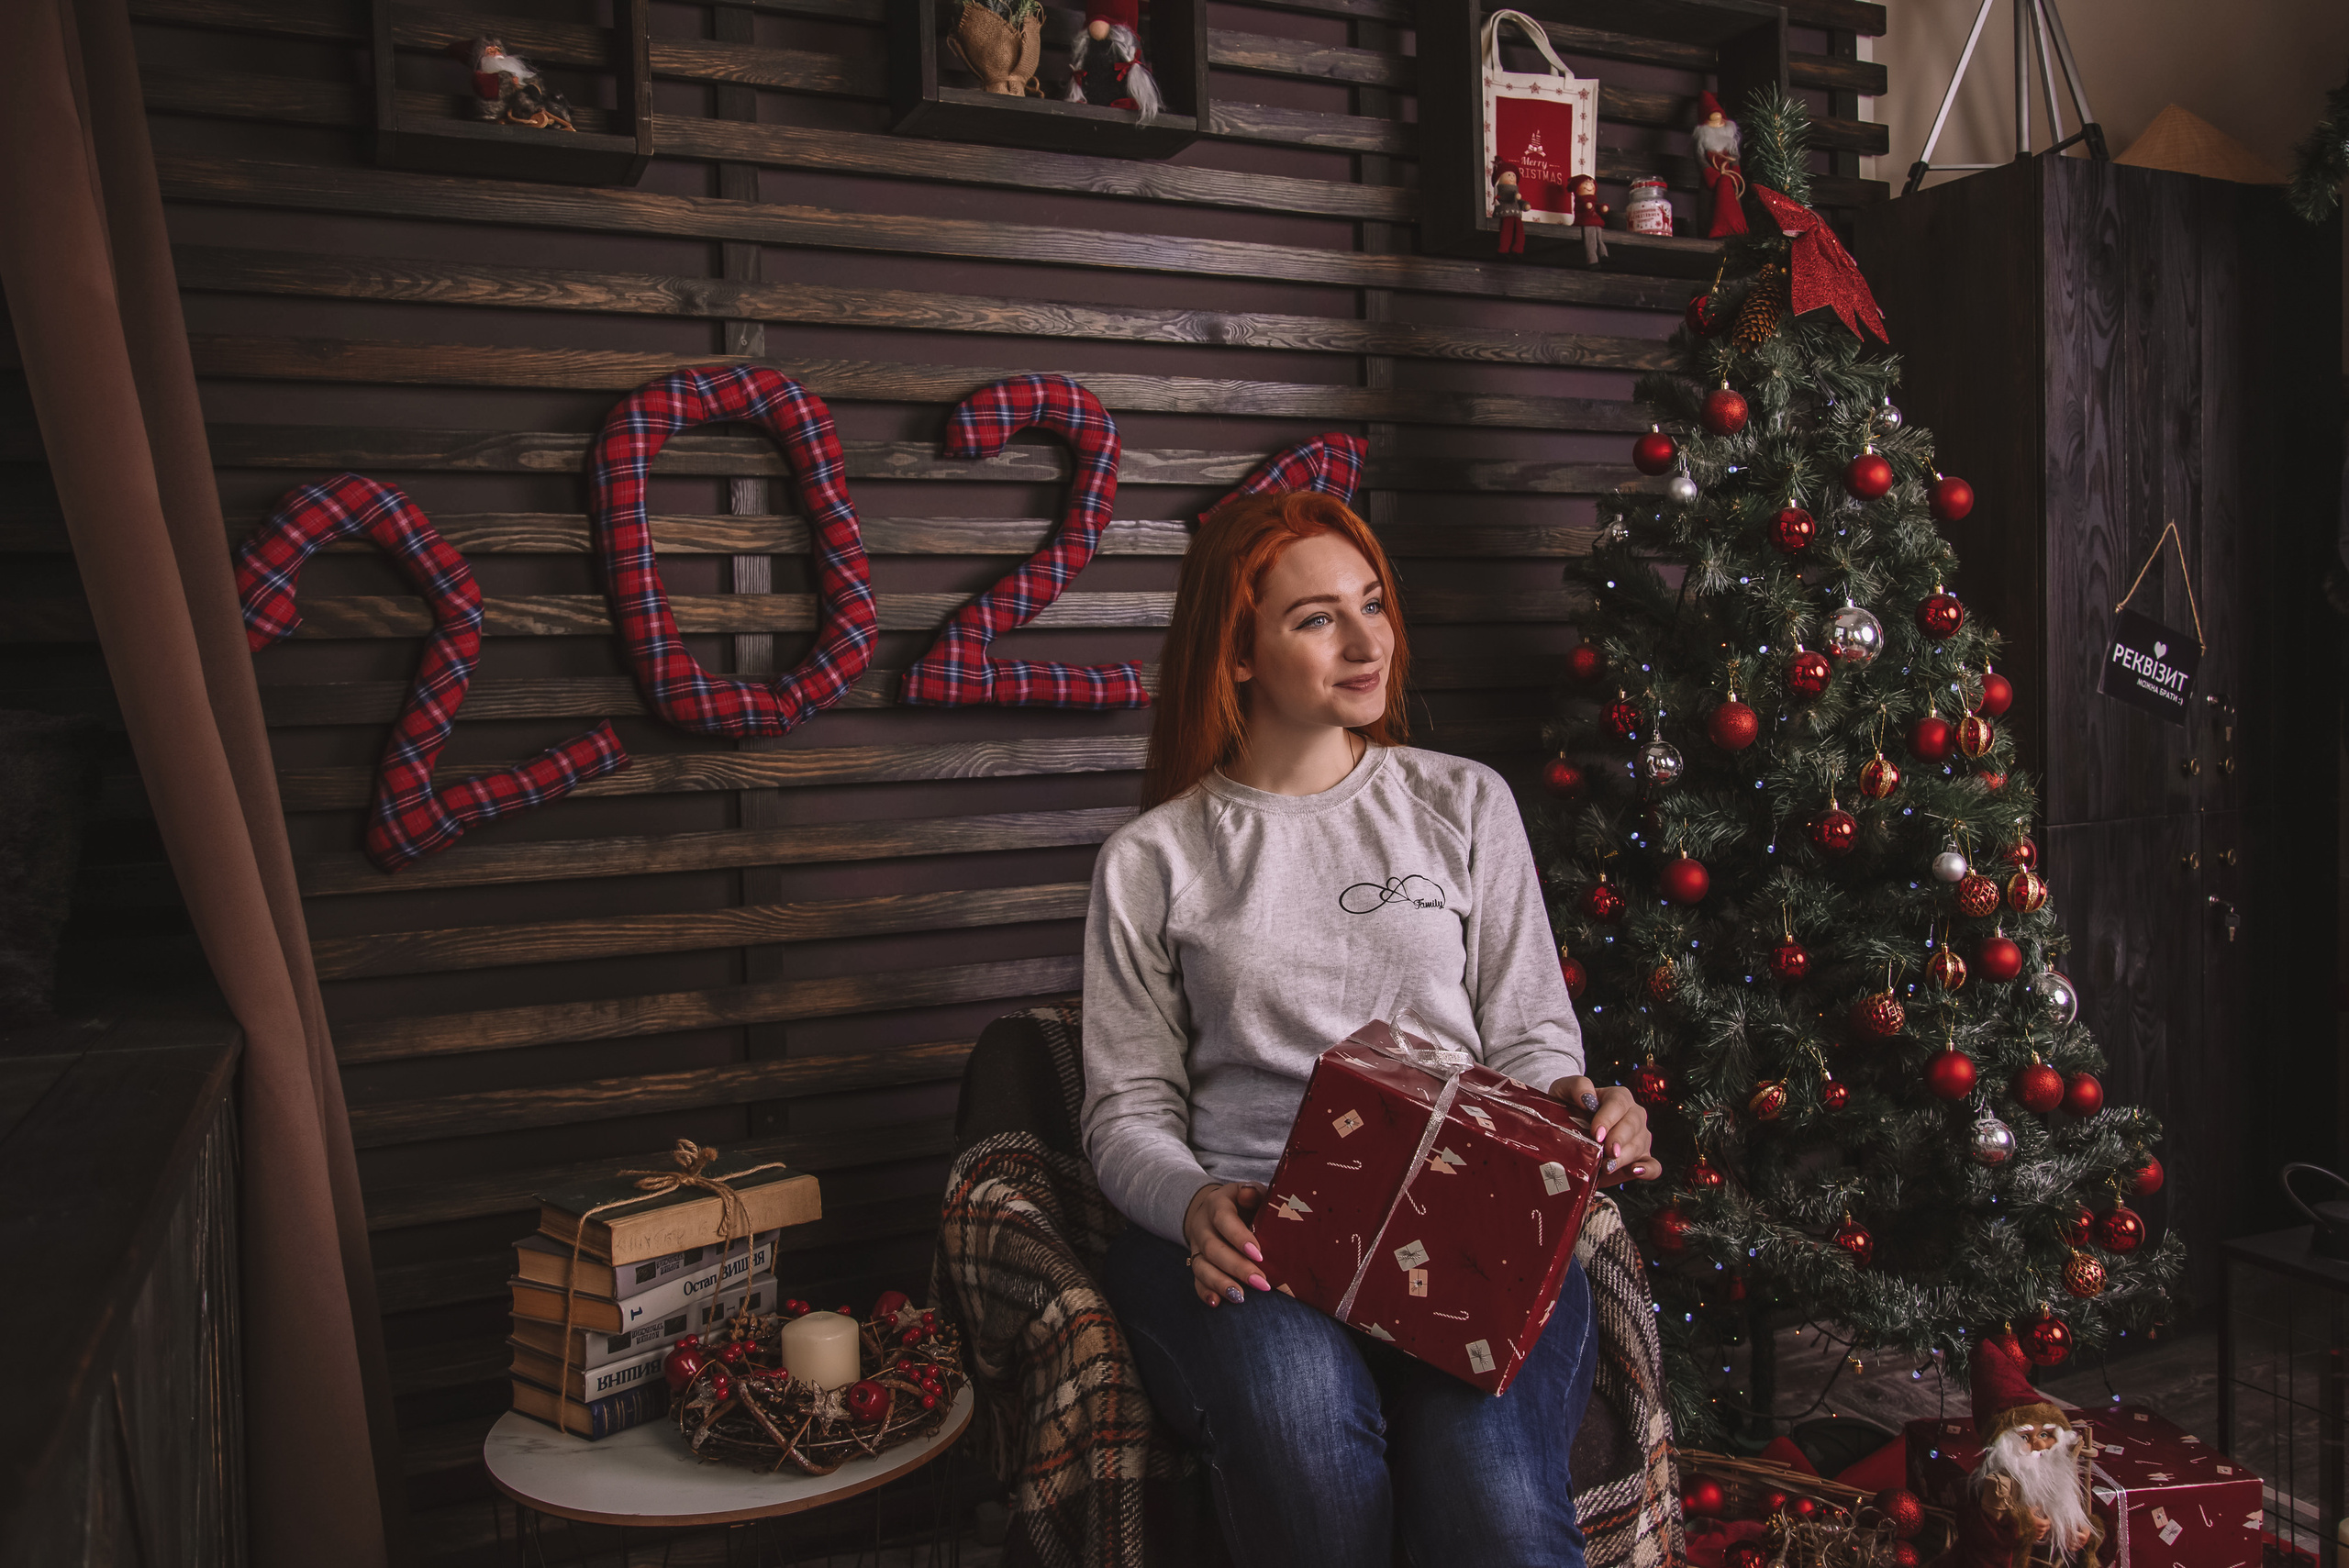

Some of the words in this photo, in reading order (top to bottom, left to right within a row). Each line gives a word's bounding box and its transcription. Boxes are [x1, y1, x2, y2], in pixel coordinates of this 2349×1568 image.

[1520, 156, 1548, 171] Merry
[1519, 167, 1563, 185] RISTMAS
[2112, 643, 2189, 692] РЕКВІЗИТ
[2136, 678, 2159, 695] МОЖНА
[2159, 687, 2178, 702] БРАТИ
[1414, 898, 1445, 910] Family
[684, 1273, 718, 1296] Остап
[597, 1359, 662, 1392] ВИШНЯ
